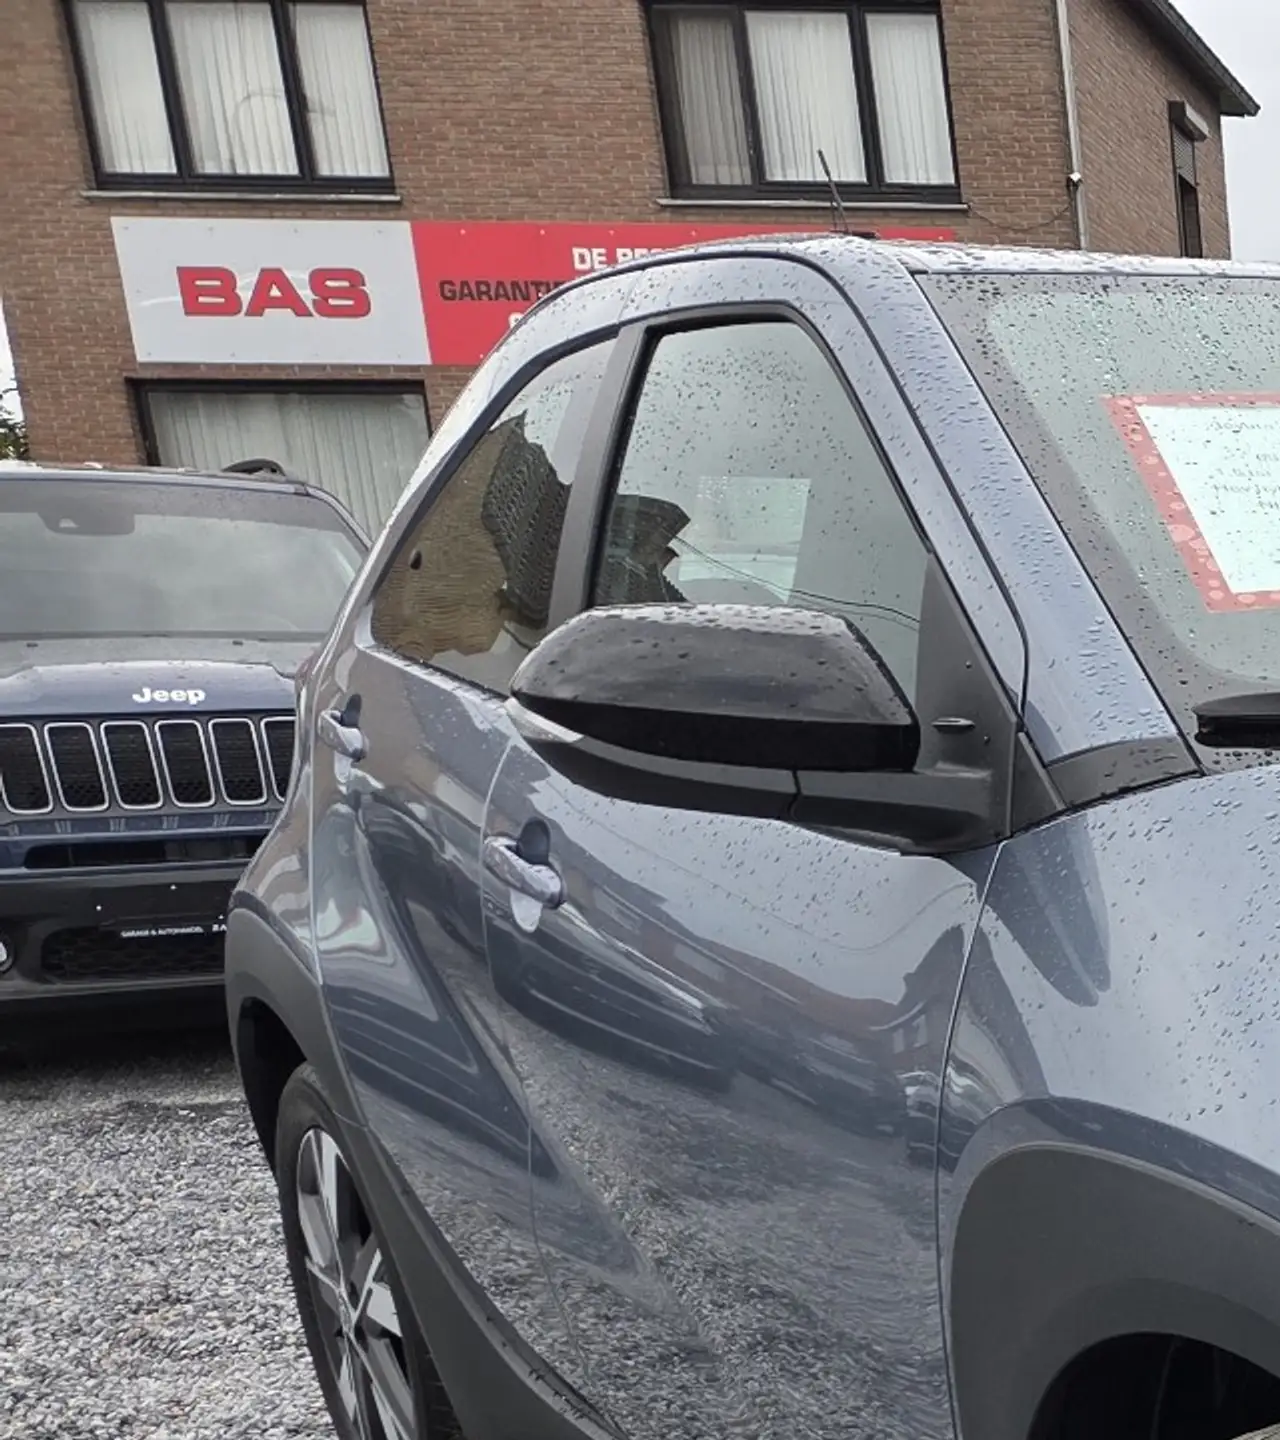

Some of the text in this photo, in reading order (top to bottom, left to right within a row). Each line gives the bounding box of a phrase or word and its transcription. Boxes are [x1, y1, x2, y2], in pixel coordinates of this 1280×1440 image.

[572, 247, 607, 270] DE
[176, 266, 372, 318] BAS
[132, 687, 206, 705] Jeep
